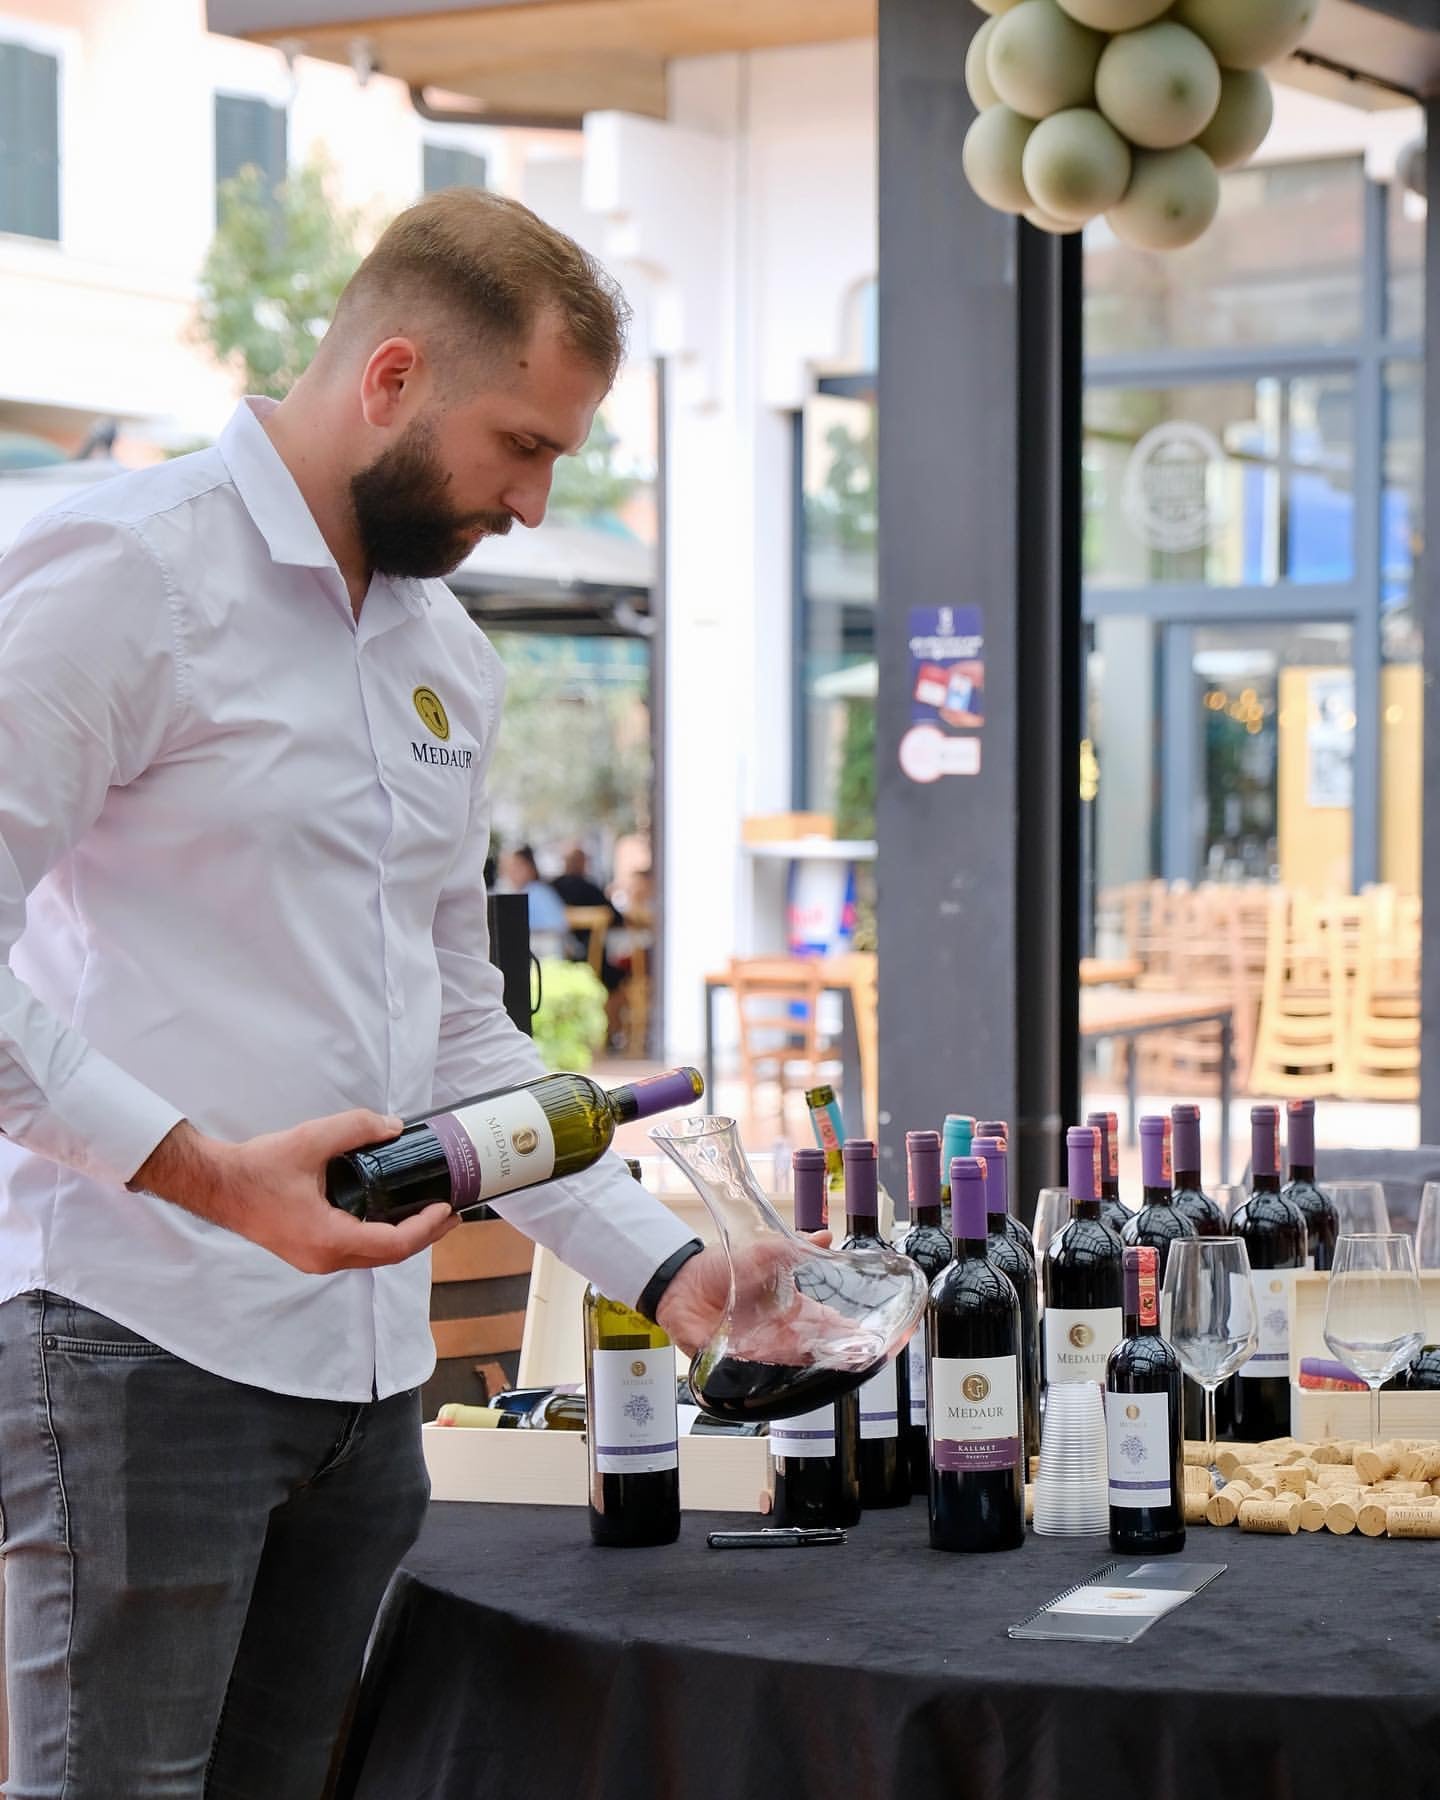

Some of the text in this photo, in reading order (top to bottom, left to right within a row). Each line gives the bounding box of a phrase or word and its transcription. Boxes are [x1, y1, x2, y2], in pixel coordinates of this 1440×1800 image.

[411, 742, 472, 769] MEDAUR
[486, 1116, 511, 1177] MEDAUR
[1056, 1352, 1107, 1364] MEDAUR
[947, 1407, 1004, 1419] MEDAUR
[958, 1444, 996, 1452] KALLMET
